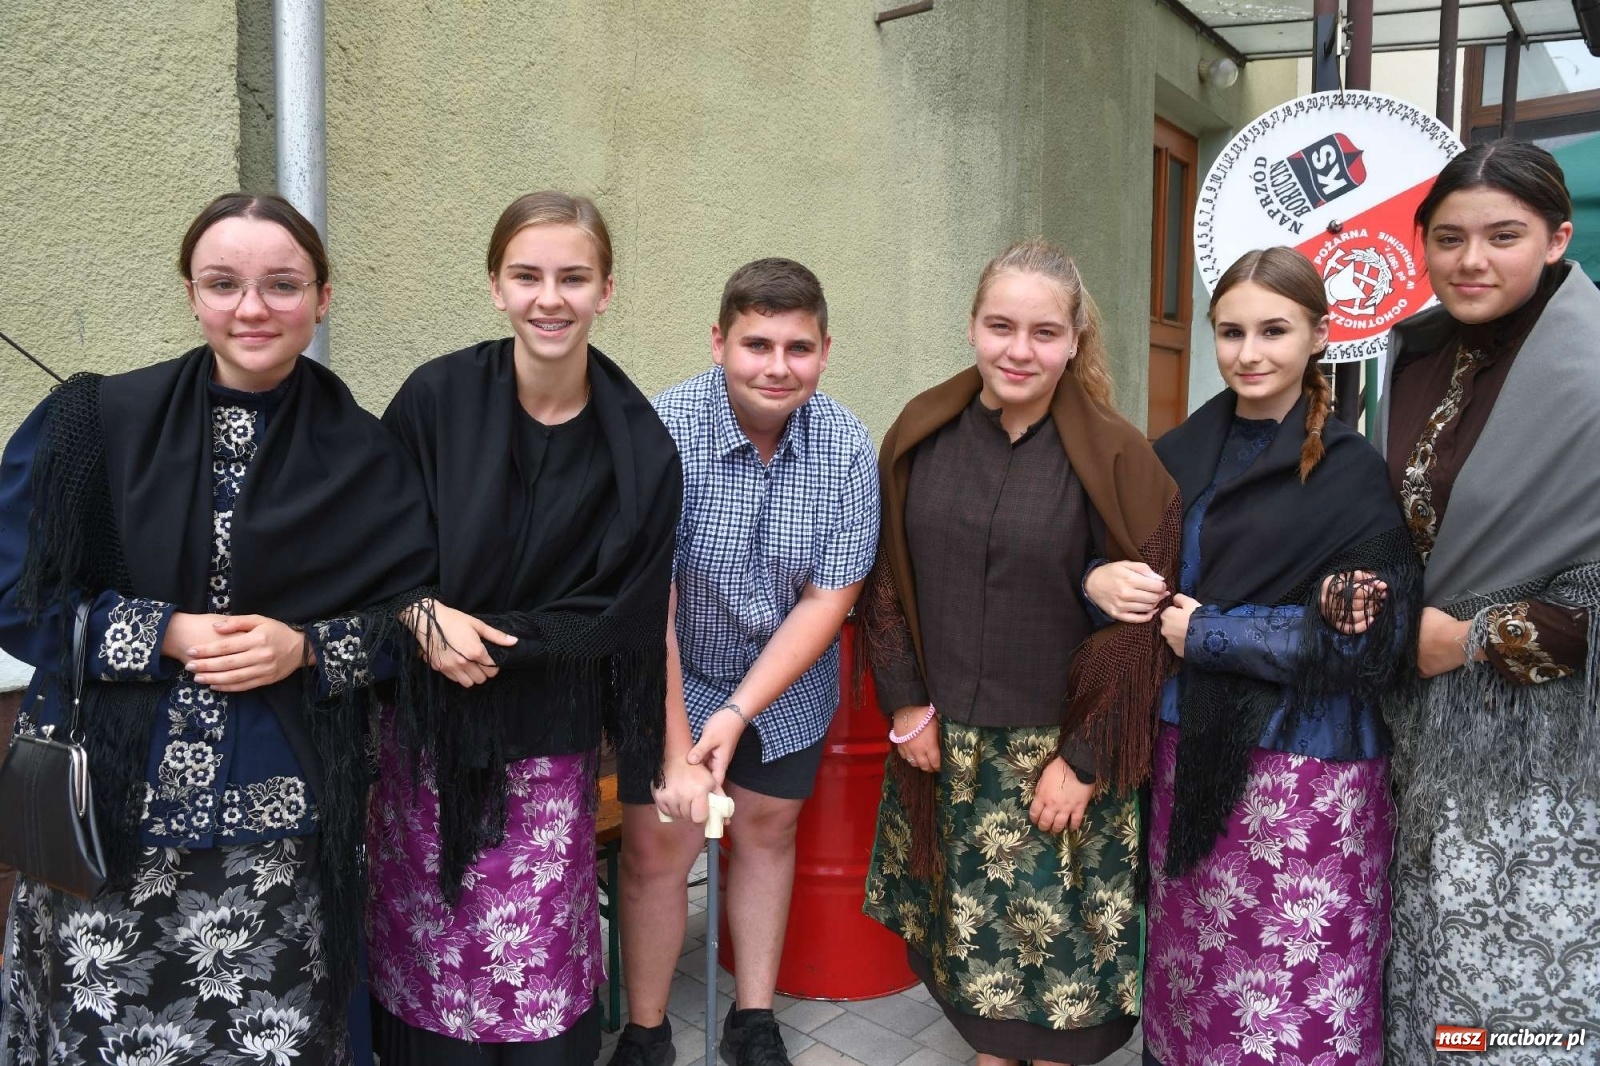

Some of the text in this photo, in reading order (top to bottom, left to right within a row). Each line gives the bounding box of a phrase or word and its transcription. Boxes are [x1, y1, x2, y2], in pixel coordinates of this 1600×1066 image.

[1307, 97, 1318, 109] 20
[1320, 95, 1330, 107] 21
[1346, 94, 1356, 105] 23
[1359, 94, 1369, 106] 24
[1282, 105, 1292, 117] 18
[1294, 101, 1305, 112] 19
[1270, 111, 1280, 122] 17
[1258, 118, 1270, 131] 16
[1248, 125, 1260, 137] 15
[1239, 134, 1251, 145] 14
[1230, 143, 1243, 155] 13
[1217, 163, 1227, 174] 11
[1311, 144, 1348, 195] KS
[1209, 174, 1222, 185] 10
[1205, 185, 1217, 193] 9
[1270, 159, 1311, 218] BORUCIN
[1249, 156, 1304, 235] NAPRZÓD
[1313, 229, 1368, 265] POŻARNA
[1200, 254, 1212, 262] 3
[1377, 231, 1416, 276] BORUCINIE
[1203, 264, 1215, 273] 2
[1329, 298, 1408, 329] OCHOTNICZA
[1341, 347, 1351, 359] 54
[1352, 345, 1364, 357] 53
[1366, 342, 1377, 355] 52
